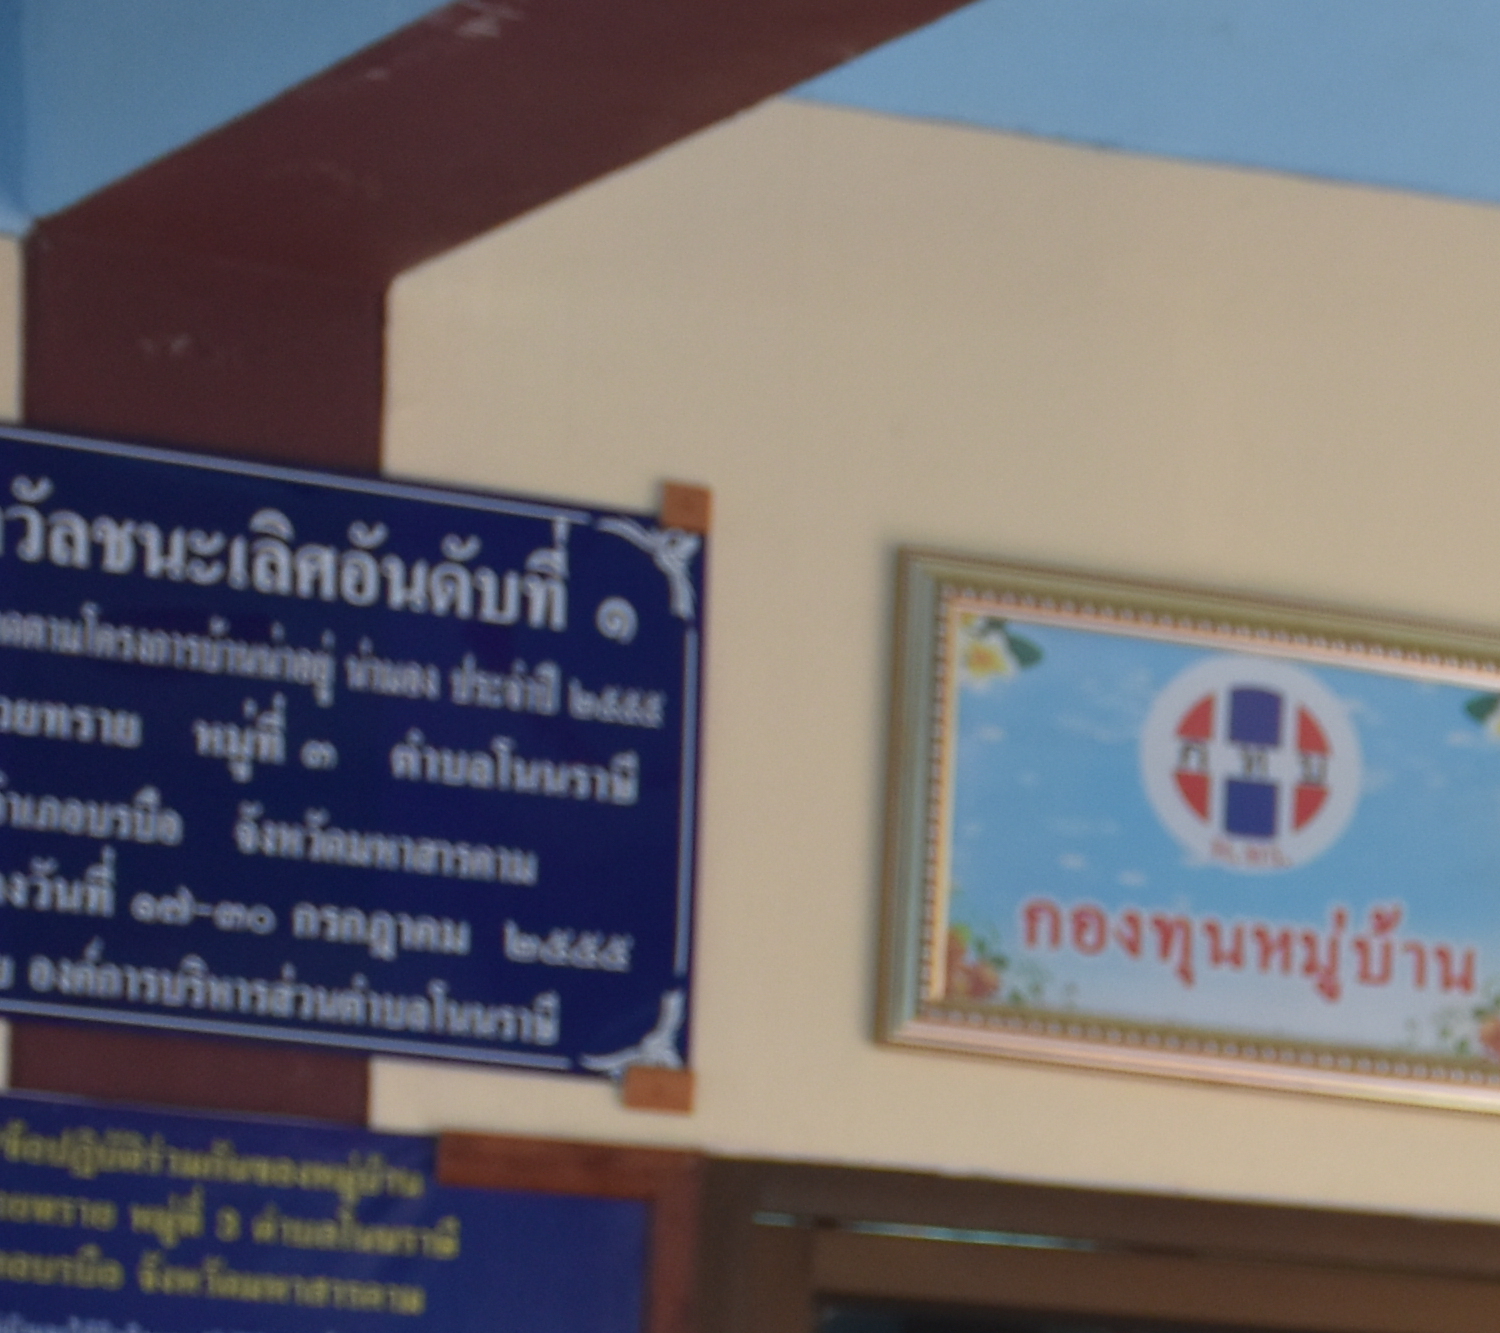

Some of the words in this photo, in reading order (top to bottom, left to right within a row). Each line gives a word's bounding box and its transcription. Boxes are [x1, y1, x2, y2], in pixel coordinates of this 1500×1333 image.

[0, 474, 570, 632] วัลชนะเลิศอันดับที่
[595, 595, 640, 647] ๑
[0, 601, 336, 707] ดตามโครงการบ้านน่าอยู่
[193, 692, 288, 784] หมู่ที่
[233, 800, 542, 887] จังหวัดมหาสารคาม
[0, 844, 117, 919] งวันที่
[291, 900, 473, 962] กรกฎาคม
[1021, 897, 1477, 1003] กองทุนหมู่บ้าน
